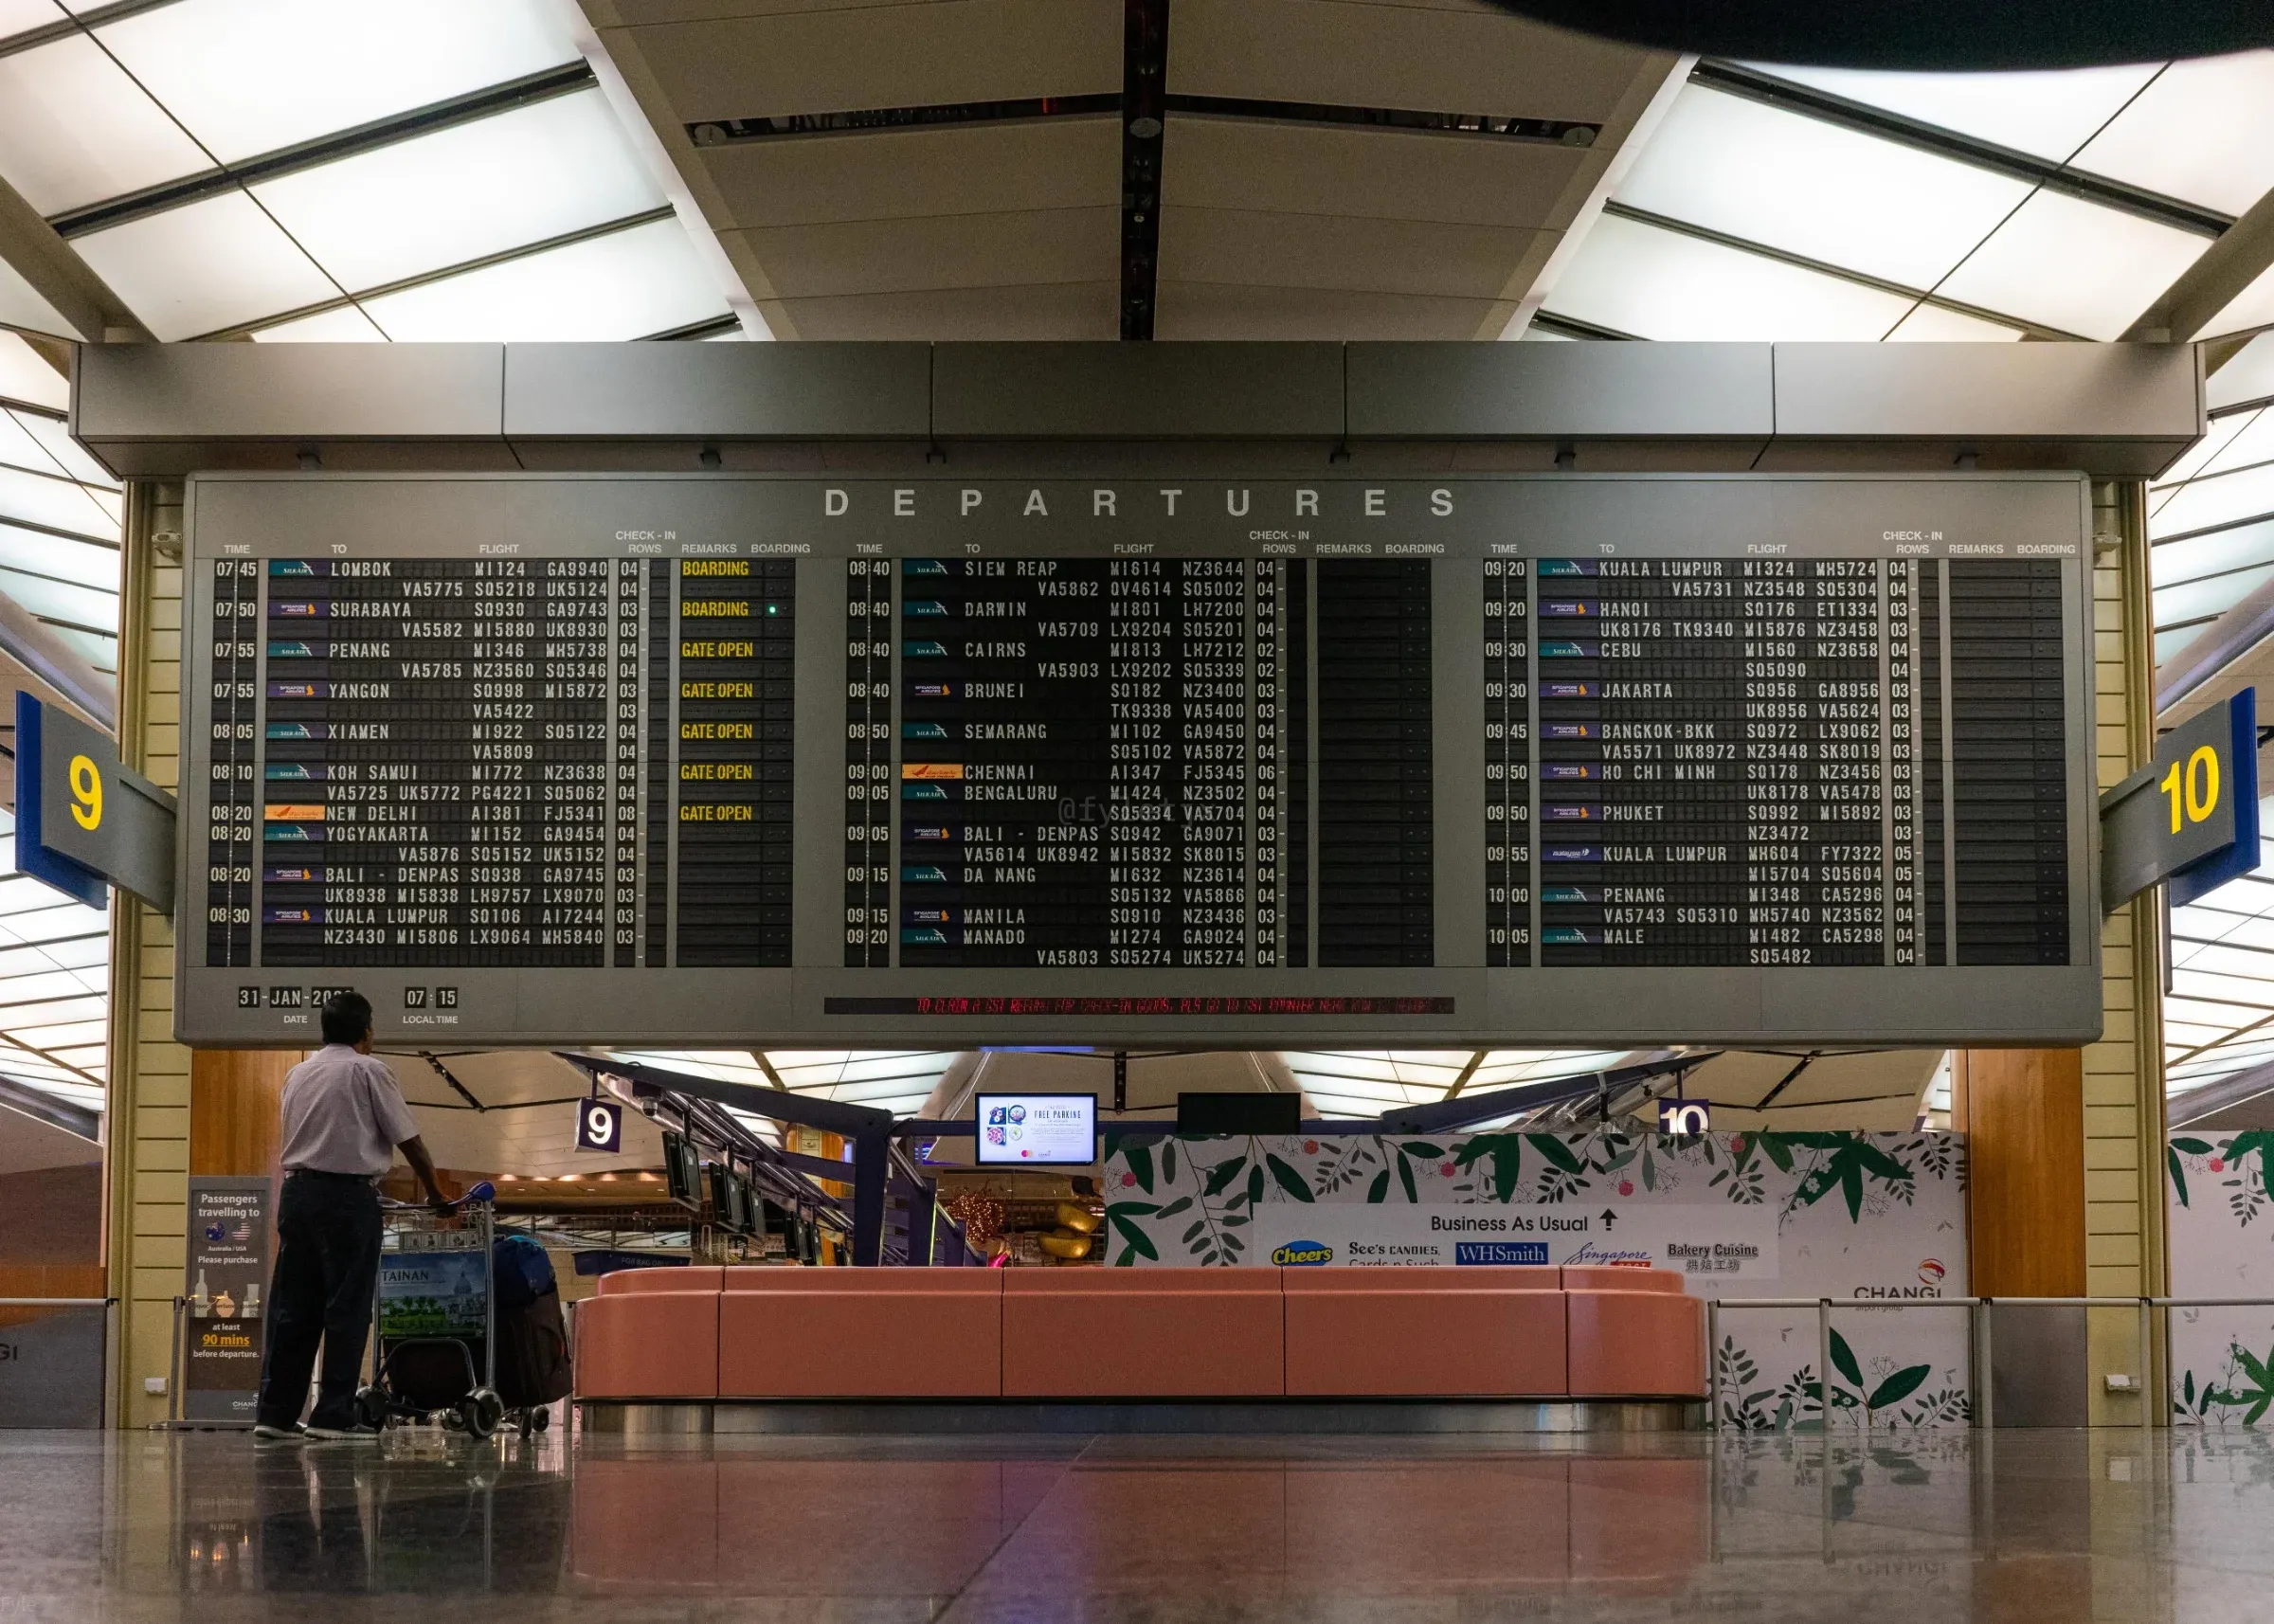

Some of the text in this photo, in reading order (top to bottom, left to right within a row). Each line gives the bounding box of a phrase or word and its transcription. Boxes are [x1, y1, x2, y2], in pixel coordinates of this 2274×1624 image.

[825, 489, 1453, 516] DEPARTURES
[225, 545, 250, 553] TIME
[332, 545, 347, 553] TO
[479, 545, 519, 553] FLIGHT
[628, 545, 661, 553] ROWS
[681, 545, 737, 553] REMARKS
[750, 544, 811, 553] BOARDING
[857, 544, 882, 553] TIME
[966, 544, 980, 553] TO
[1113, 544, 1154, 553] FLIGHT
[1263, 545, 1296, 553] ROWS
[1316, 545, 1372, 553] REMARKS
[1385, 544, 1445, 553] BOARDING
[1491, 544, 1517, 553] TIME
[1599, 544, 1614, 553] TO
[1747, 544, 1787, 553] FLIGHT
[1896, 545, 1929, 553] ROWS
[1949, 545, 2004, 553] REMARKS
[2017, 544, 2076, 553] BOARDING
[332, 562, 390, 576] LOMBOK
[476, 562, 524, 576] MI124
[683, 562, 749, 575] BOARDING
[966, 562, 1004, 575] SIEM
[1018, 562, 1056, 575] REAP
[1111, 562, 1160, 575] MI614
[1600, 562, 1650, 575] KUALA
[1663, 562, 1722, 576] LUMPUR
[1744, 562, 1794, 575] MI324
[331, 603, 410, 617] SURABAYA
[683, 603, 748, 616] BOARDING
[966, 602, 1158, 616] DARWIN MI801
[1600, 603, 1795, 616] HANOI SQ176
[330, 643, 389, 658] PENANG
[682, 642, 752, 657] GATE OPEN
[966, 642, 1025, 657] CAIRNS
[1601, 643, 1640, 657] CEBU
[330, 684, 523, 697] YANGON SQ998
[682, 683, 752, 697] GATE OPEN
[966, 683, 1022, 697] BRUNEI
[1602, 683, 1796, 697] JAKARTA SQ956
[329, 725, 522, 739] XIAMEN MI922
[682, 724, 751, 738] GATE OPEN
[966, 724, 1161, 738] SEMARANG MI102
[1603, 725, 1714, 738] BANGKOK-BKK
[328, 766, 522, 780] KOH SAMUI MI772
[681, 766, 751, 779] GATE OPEN
[965, 766, 1033, 779] CHENNAI
[1111, 766, 1160, 779] AI347
[1603, 766, 1714, 779] HO CHI MINH
[69, 755, 103, 830] 9
[966, 785, 1056, 800] BENGALURU
[2161, 746, 2219, 835] 10
[327, 806, 355, 821] NEW
[369, 806, 415, 821] DELHI
[472, 806, 519, 821] AI381
[681, 806, 751, 820] GATE OPEN
[1604, 806, 1663, 820] PHUKET
[327, 827, 427, 840] YOGYAKARTA
[965, 826, 1161, 840] BALI DENPAS SQ942
[1604, 846, 1798, 861] KUALA LUMPUR MH604
[326, 868, 520, 882] BALI DENPAS SQ938
[965, 868, 1035, 882] DA NANG
[1604, 888, 1664, 902] PENANG
[325, 909, 520, 923] KUALA LUMPUR SQ106
[965, 909, 1160, 923] MANILA SQ910
[964, 929, 1024, 944] MANADO
[1604, 929, 1799, 944] MALE MI482
[283, 1015, 307, 1023] DATE
[403, 1015, 458, 1023] LOCAL TIME
[588, 1107, 612, 1145] 9
[1660, 1105, 1708, 1134] 10
[201, 1194, 258, 1206] Passengers
[198, 1207, 261, 1219] travelling to
[1432, 1216, 1588, 1231] Business As Usual
[1349, 1241, 1384, 1254] See's
[1460, 1245, 1545, 1261] WHSmith
[1563, 1242, 1652, 1265] Singapore
[1668, 1243, 1760, 1259] Bakery Cuisine
[197, 1255, 259, 1266] Please purchase
[1272, 1247, 1333, 1266] Cheers
[382, 1271, 428, 1281] TAINAN
[1853, 1287, 1941, 1299] CHANGI
[222, 1323, 241, 1331] least
[202, 1334, 250, 1345] 90 mins
[218, 1350, 260, 1360] departure.
